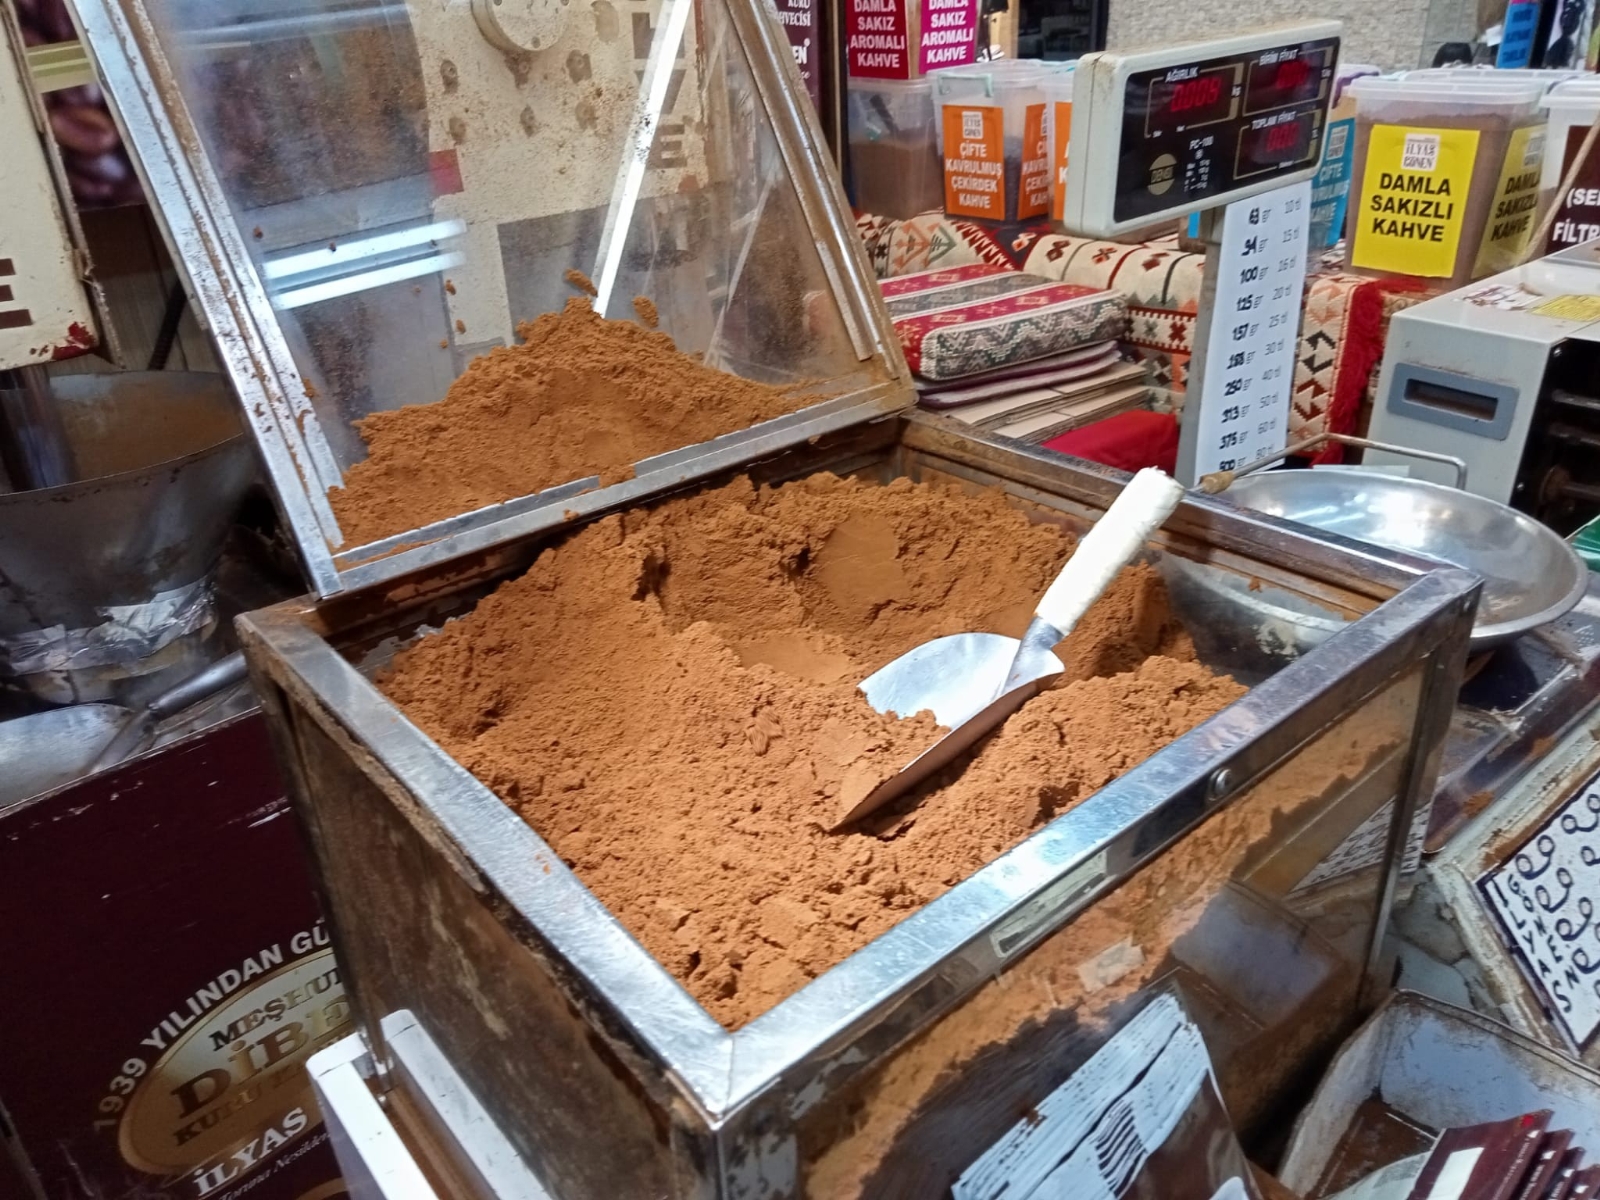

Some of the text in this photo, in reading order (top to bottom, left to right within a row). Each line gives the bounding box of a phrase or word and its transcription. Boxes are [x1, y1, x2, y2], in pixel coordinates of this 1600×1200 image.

[853, 0, 897, 12] DAMLA
[778, 10, 811, 27] HVECİSİ
[857, 16, 895, 31] SAKIZ
[930, 10, 966, 28] SAKIZ
[850, 34, 905, 50] AROMALI
[921, 27, 974, 47] AROMALI
[857, 52, 900, 68] KAHVE
[926, 45, 967, 64] KAHVE
[960, 141, 987, 158] ÇİFTE
[945, 158, 1003, 179] KAVRULMUŞ
[951, 175, 998, 192] ÇEKİRDEK
[1379, 172, 1451, 196] DAMLA
[959, 193, 991, 209] KAHVE
[1370, 194, 1454, 220] SAKIZLI
[1372, 218, 1445, 242] KAHVE
[1240, 265, 1258, 284] 100
[95, 1057, 147, 1131] 1939
[140, 943, 283, 1051] YILINDAN
[170, 999, 351, 1119] DİBE
[193, 1107, 308, 1196] İLYAS
